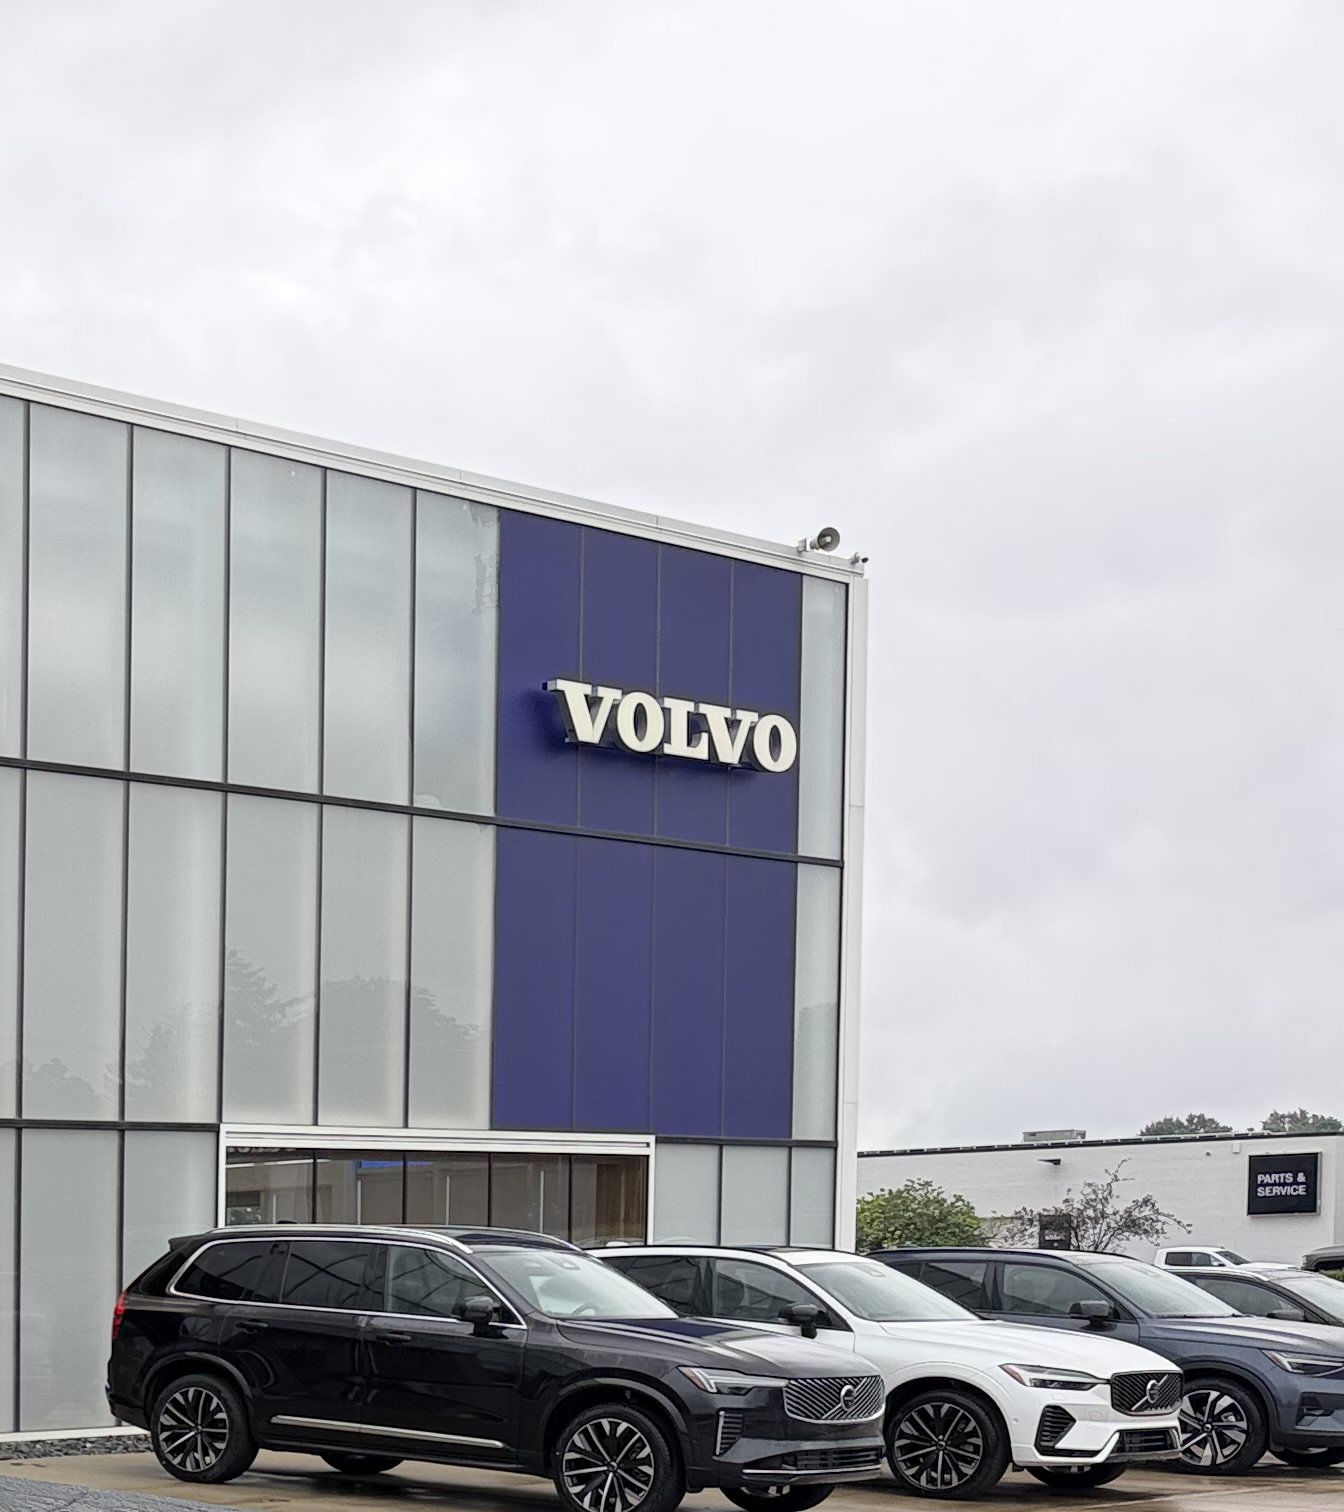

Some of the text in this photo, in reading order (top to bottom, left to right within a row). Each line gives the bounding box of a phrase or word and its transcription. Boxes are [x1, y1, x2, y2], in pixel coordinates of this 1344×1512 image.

[548, 678, 797, 773] VOLVO
[1257, 1172, 1306, 1184] PARTS &
[1257, 1184, 1306, 1197] SERVICE
